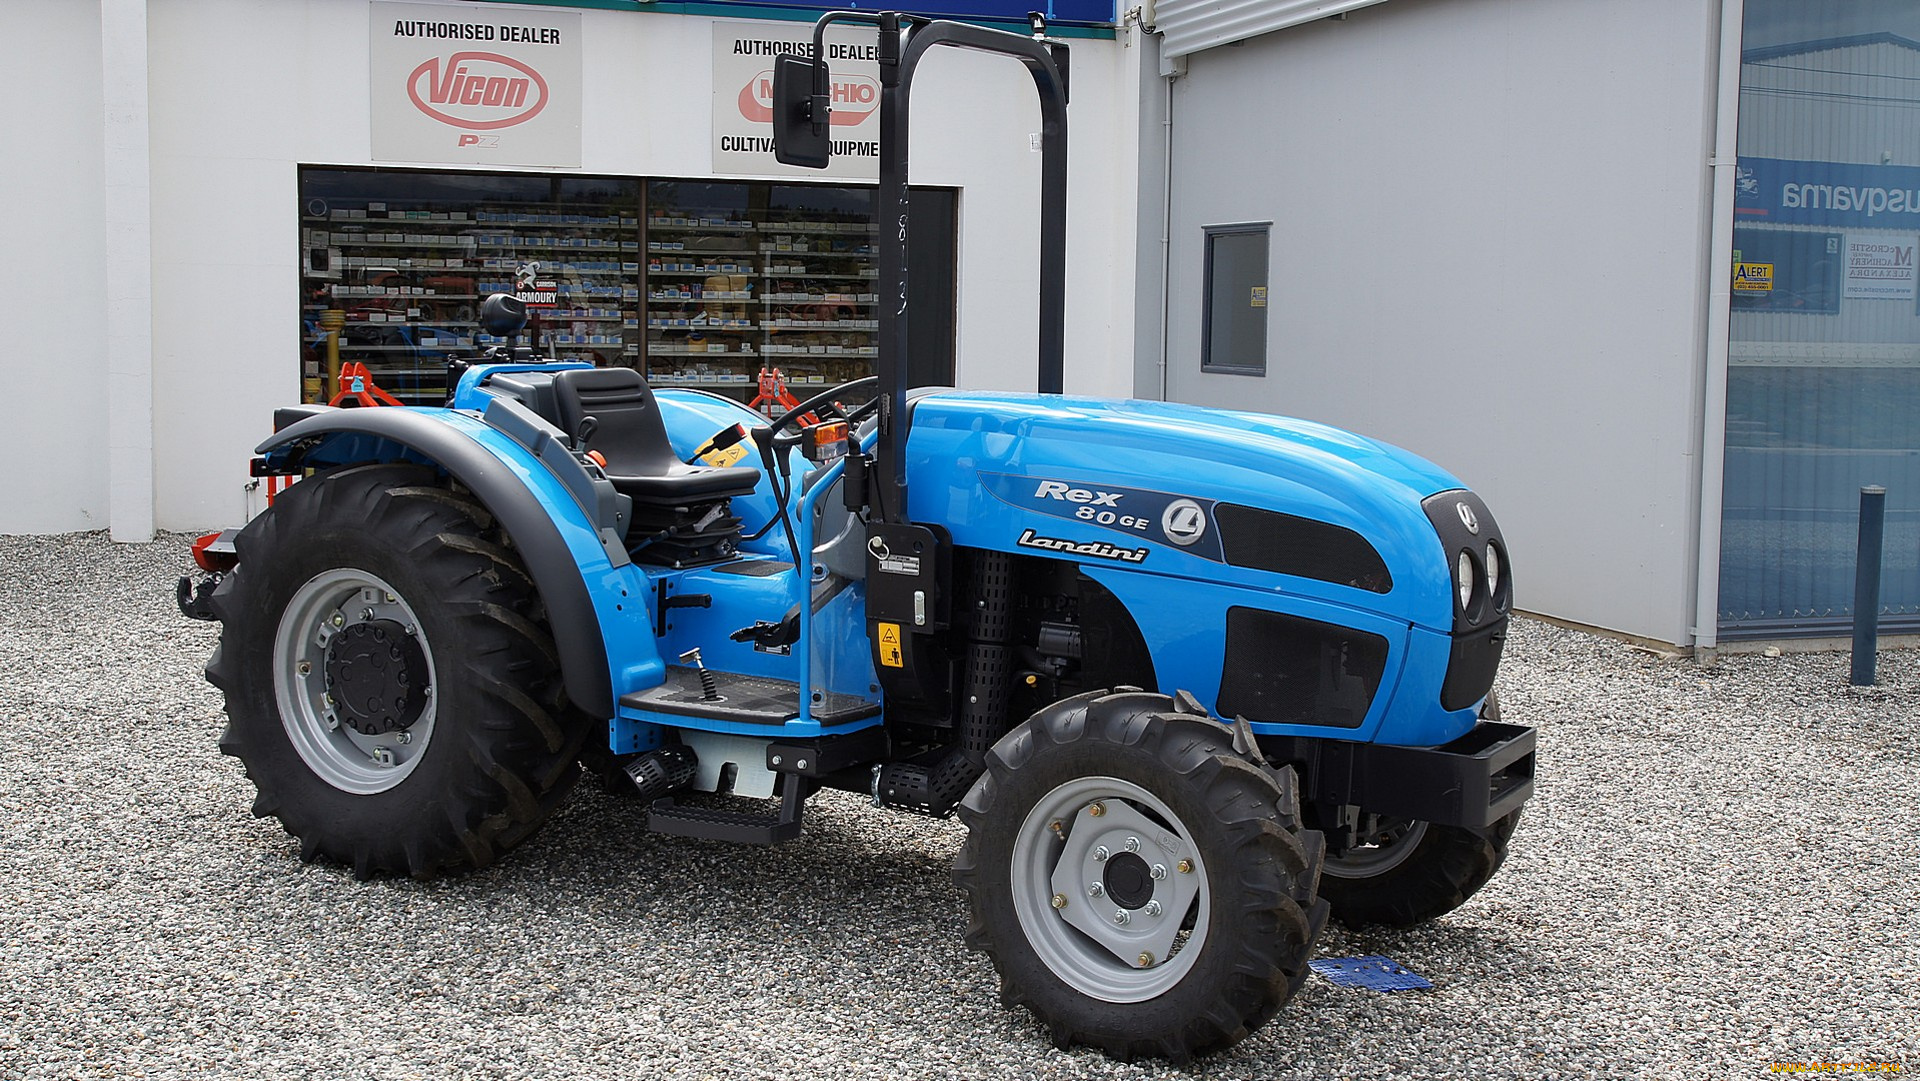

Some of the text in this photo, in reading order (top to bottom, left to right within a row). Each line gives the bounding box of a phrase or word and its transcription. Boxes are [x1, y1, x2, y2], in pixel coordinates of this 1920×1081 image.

[394, 20, 560, 45] AUTHORISED DEALER
[733, 39, 814, 58] AUTHORISE
[429, 56, 529, 108] Vicon
[1735, 264, 1768, 281] ALERT
[516, 291, 557, 303] ARMOURY
[1034, 480, 1124, 507] Rex
[1018, 530, 1148, 563] Landini
